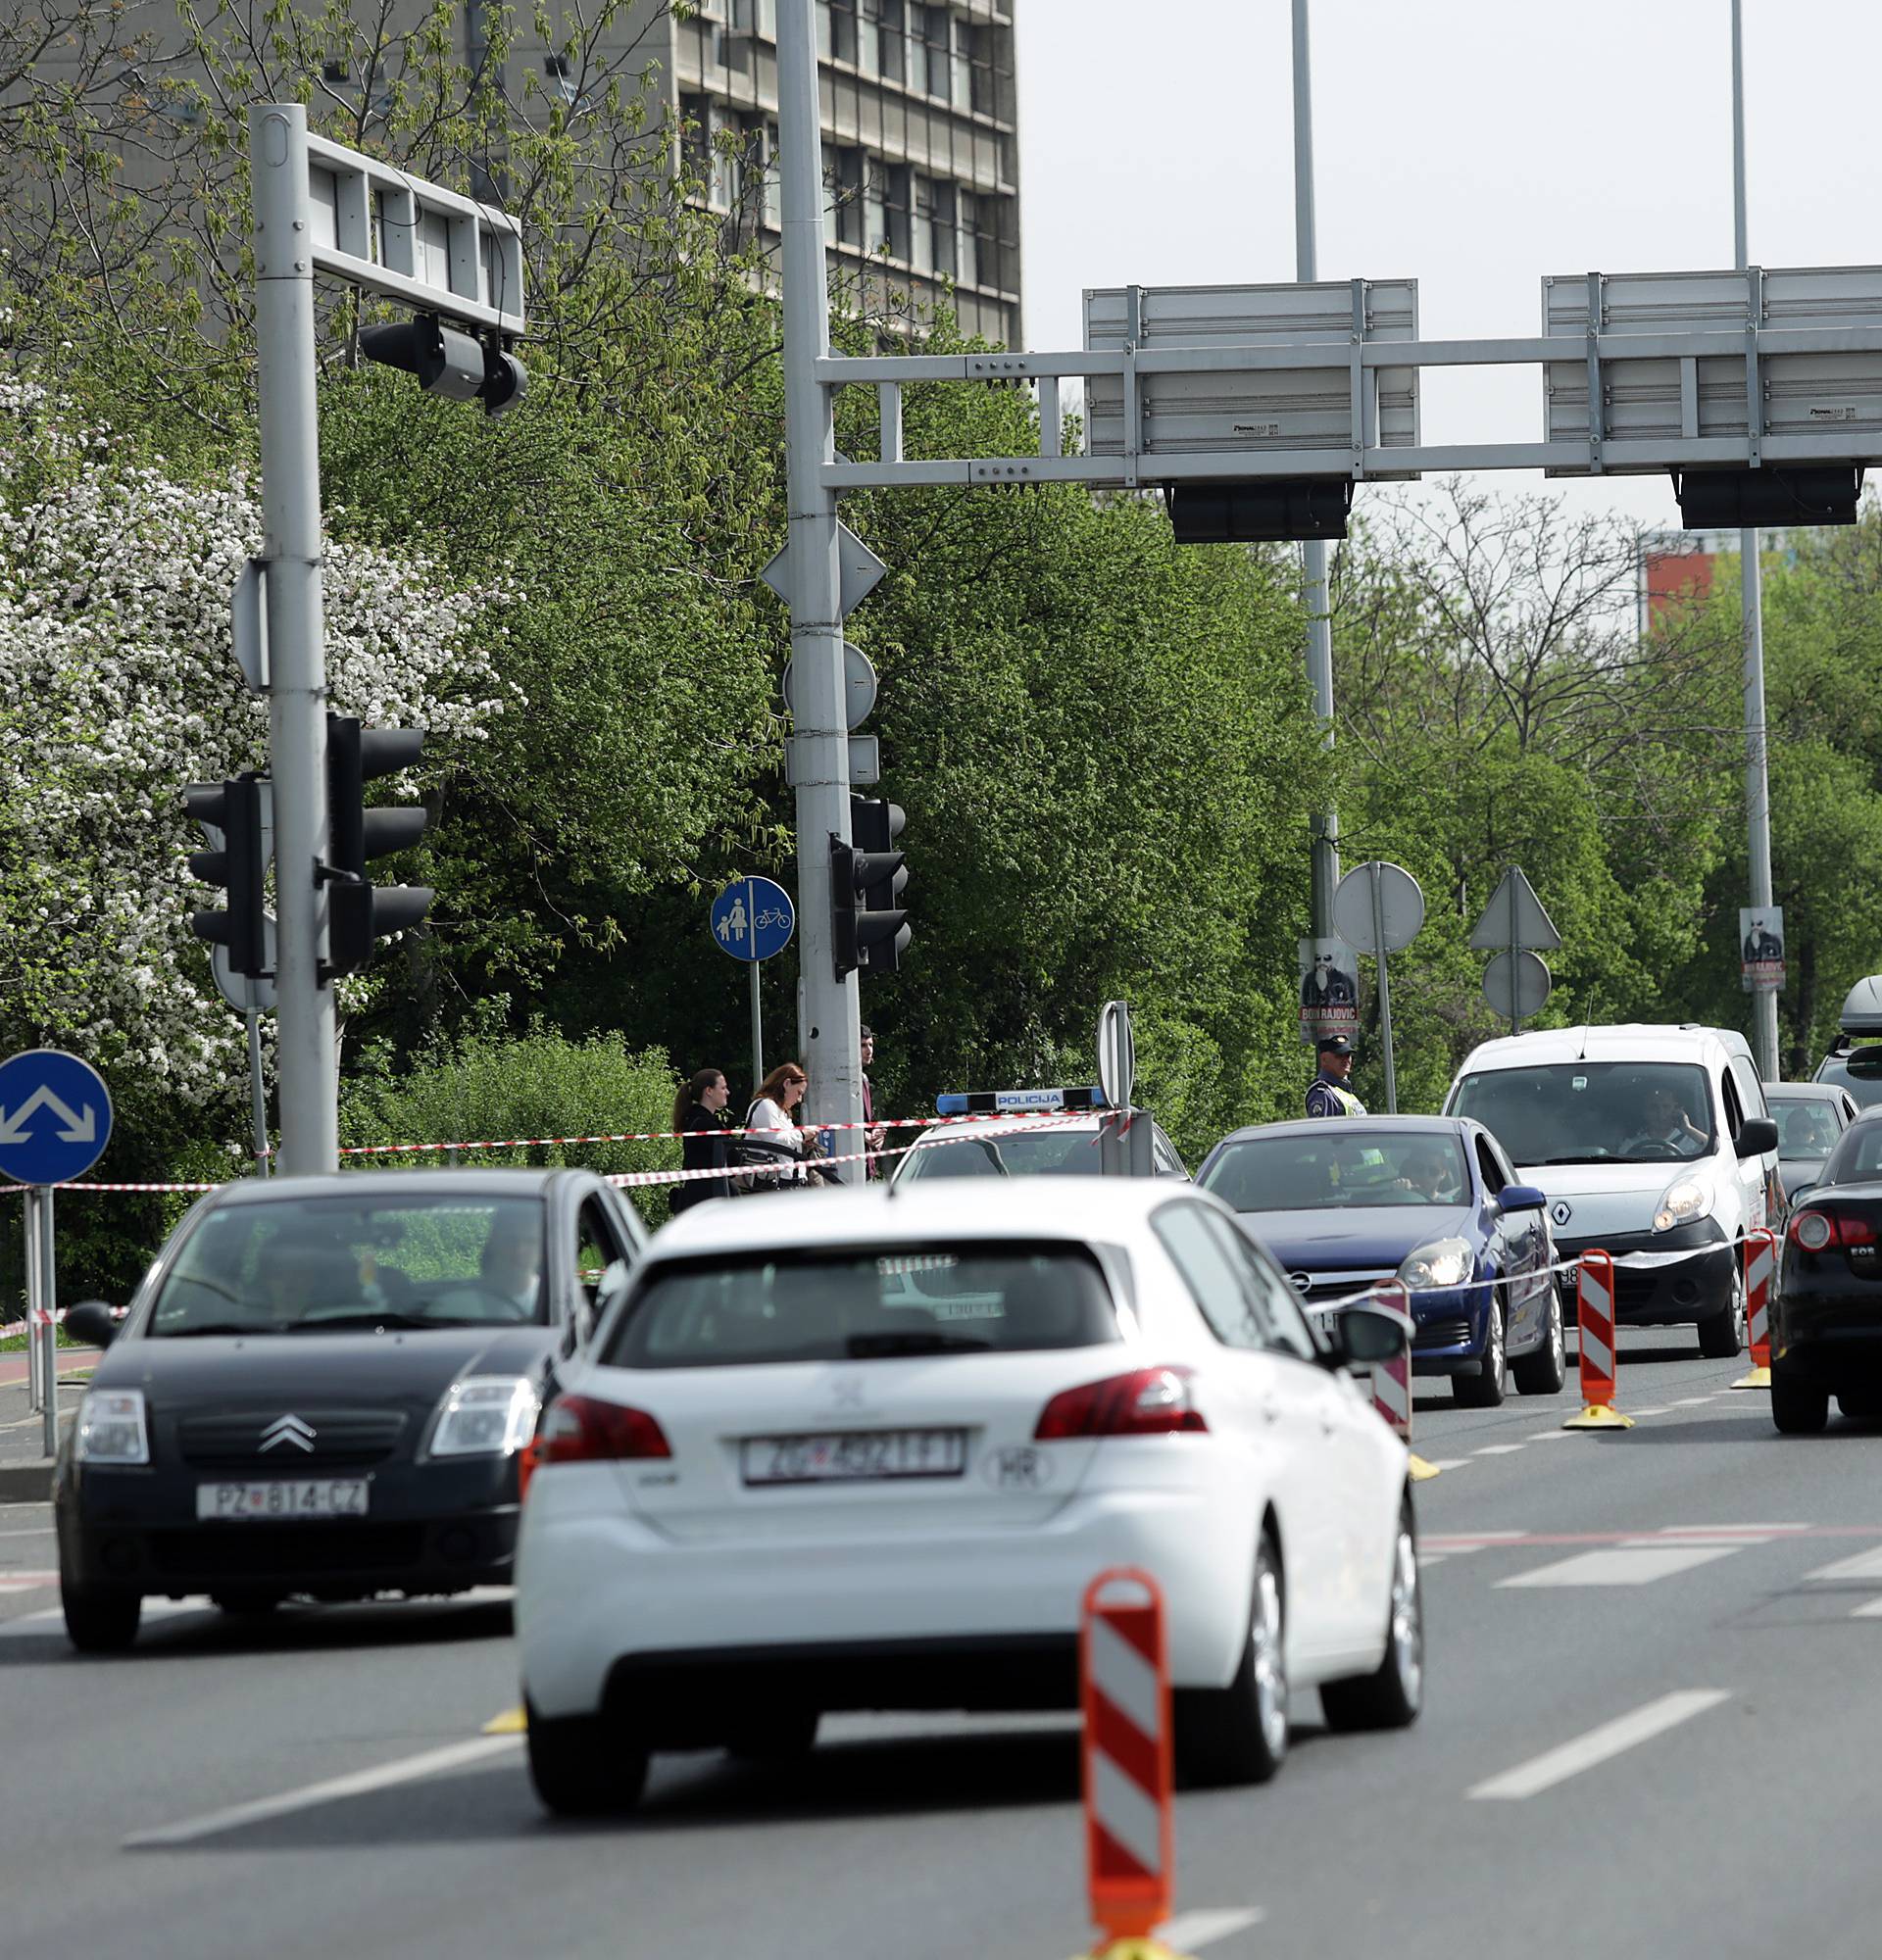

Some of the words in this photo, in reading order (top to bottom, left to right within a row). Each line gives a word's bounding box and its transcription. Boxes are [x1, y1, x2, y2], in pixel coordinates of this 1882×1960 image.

[998, 1094, 1061, 1105] POLICIJA
[998, 1446, 1038, 1490] HR
[216, 1482, 246, 1516] PZ
